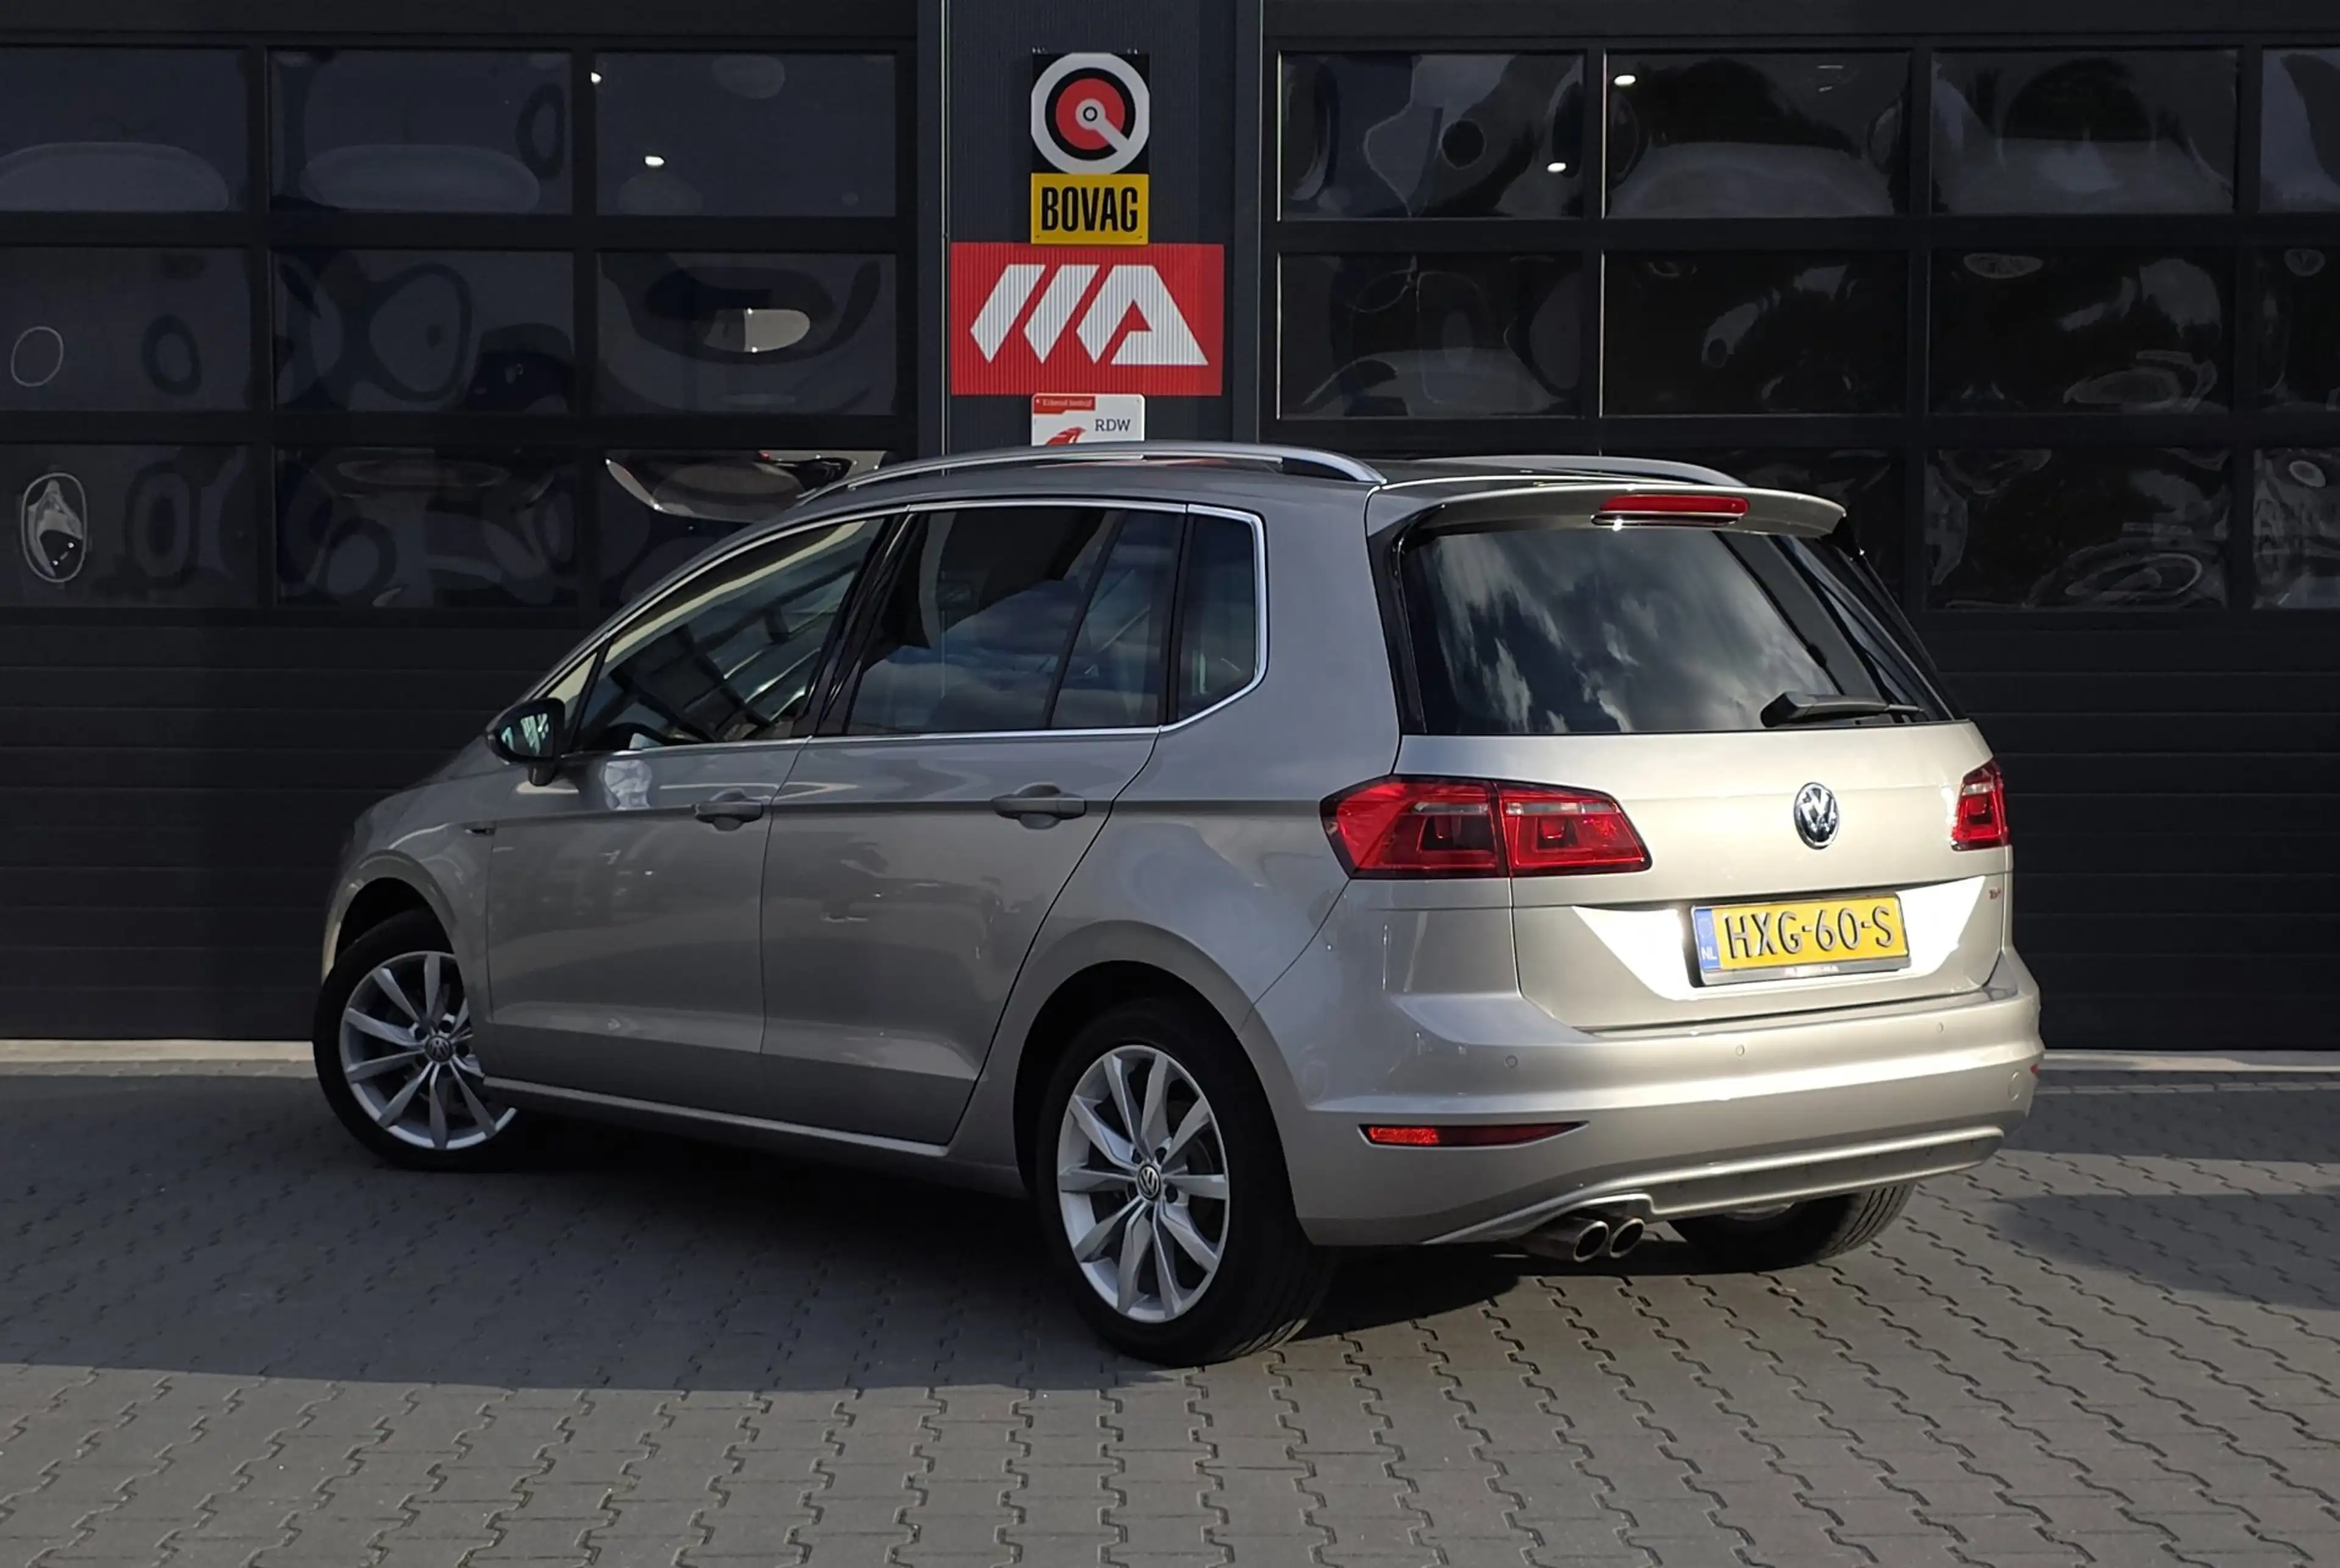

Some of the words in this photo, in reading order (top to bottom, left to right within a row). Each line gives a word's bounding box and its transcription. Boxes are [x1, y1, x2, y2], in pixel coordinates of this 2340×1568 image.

[1041, 186, 1138, 232] BOVAG
[1094, 419, 1131, 431] RDW
[1724, 906, 1895, 959] HXG-60-S
[1701, 946, 1717, 960] NL
